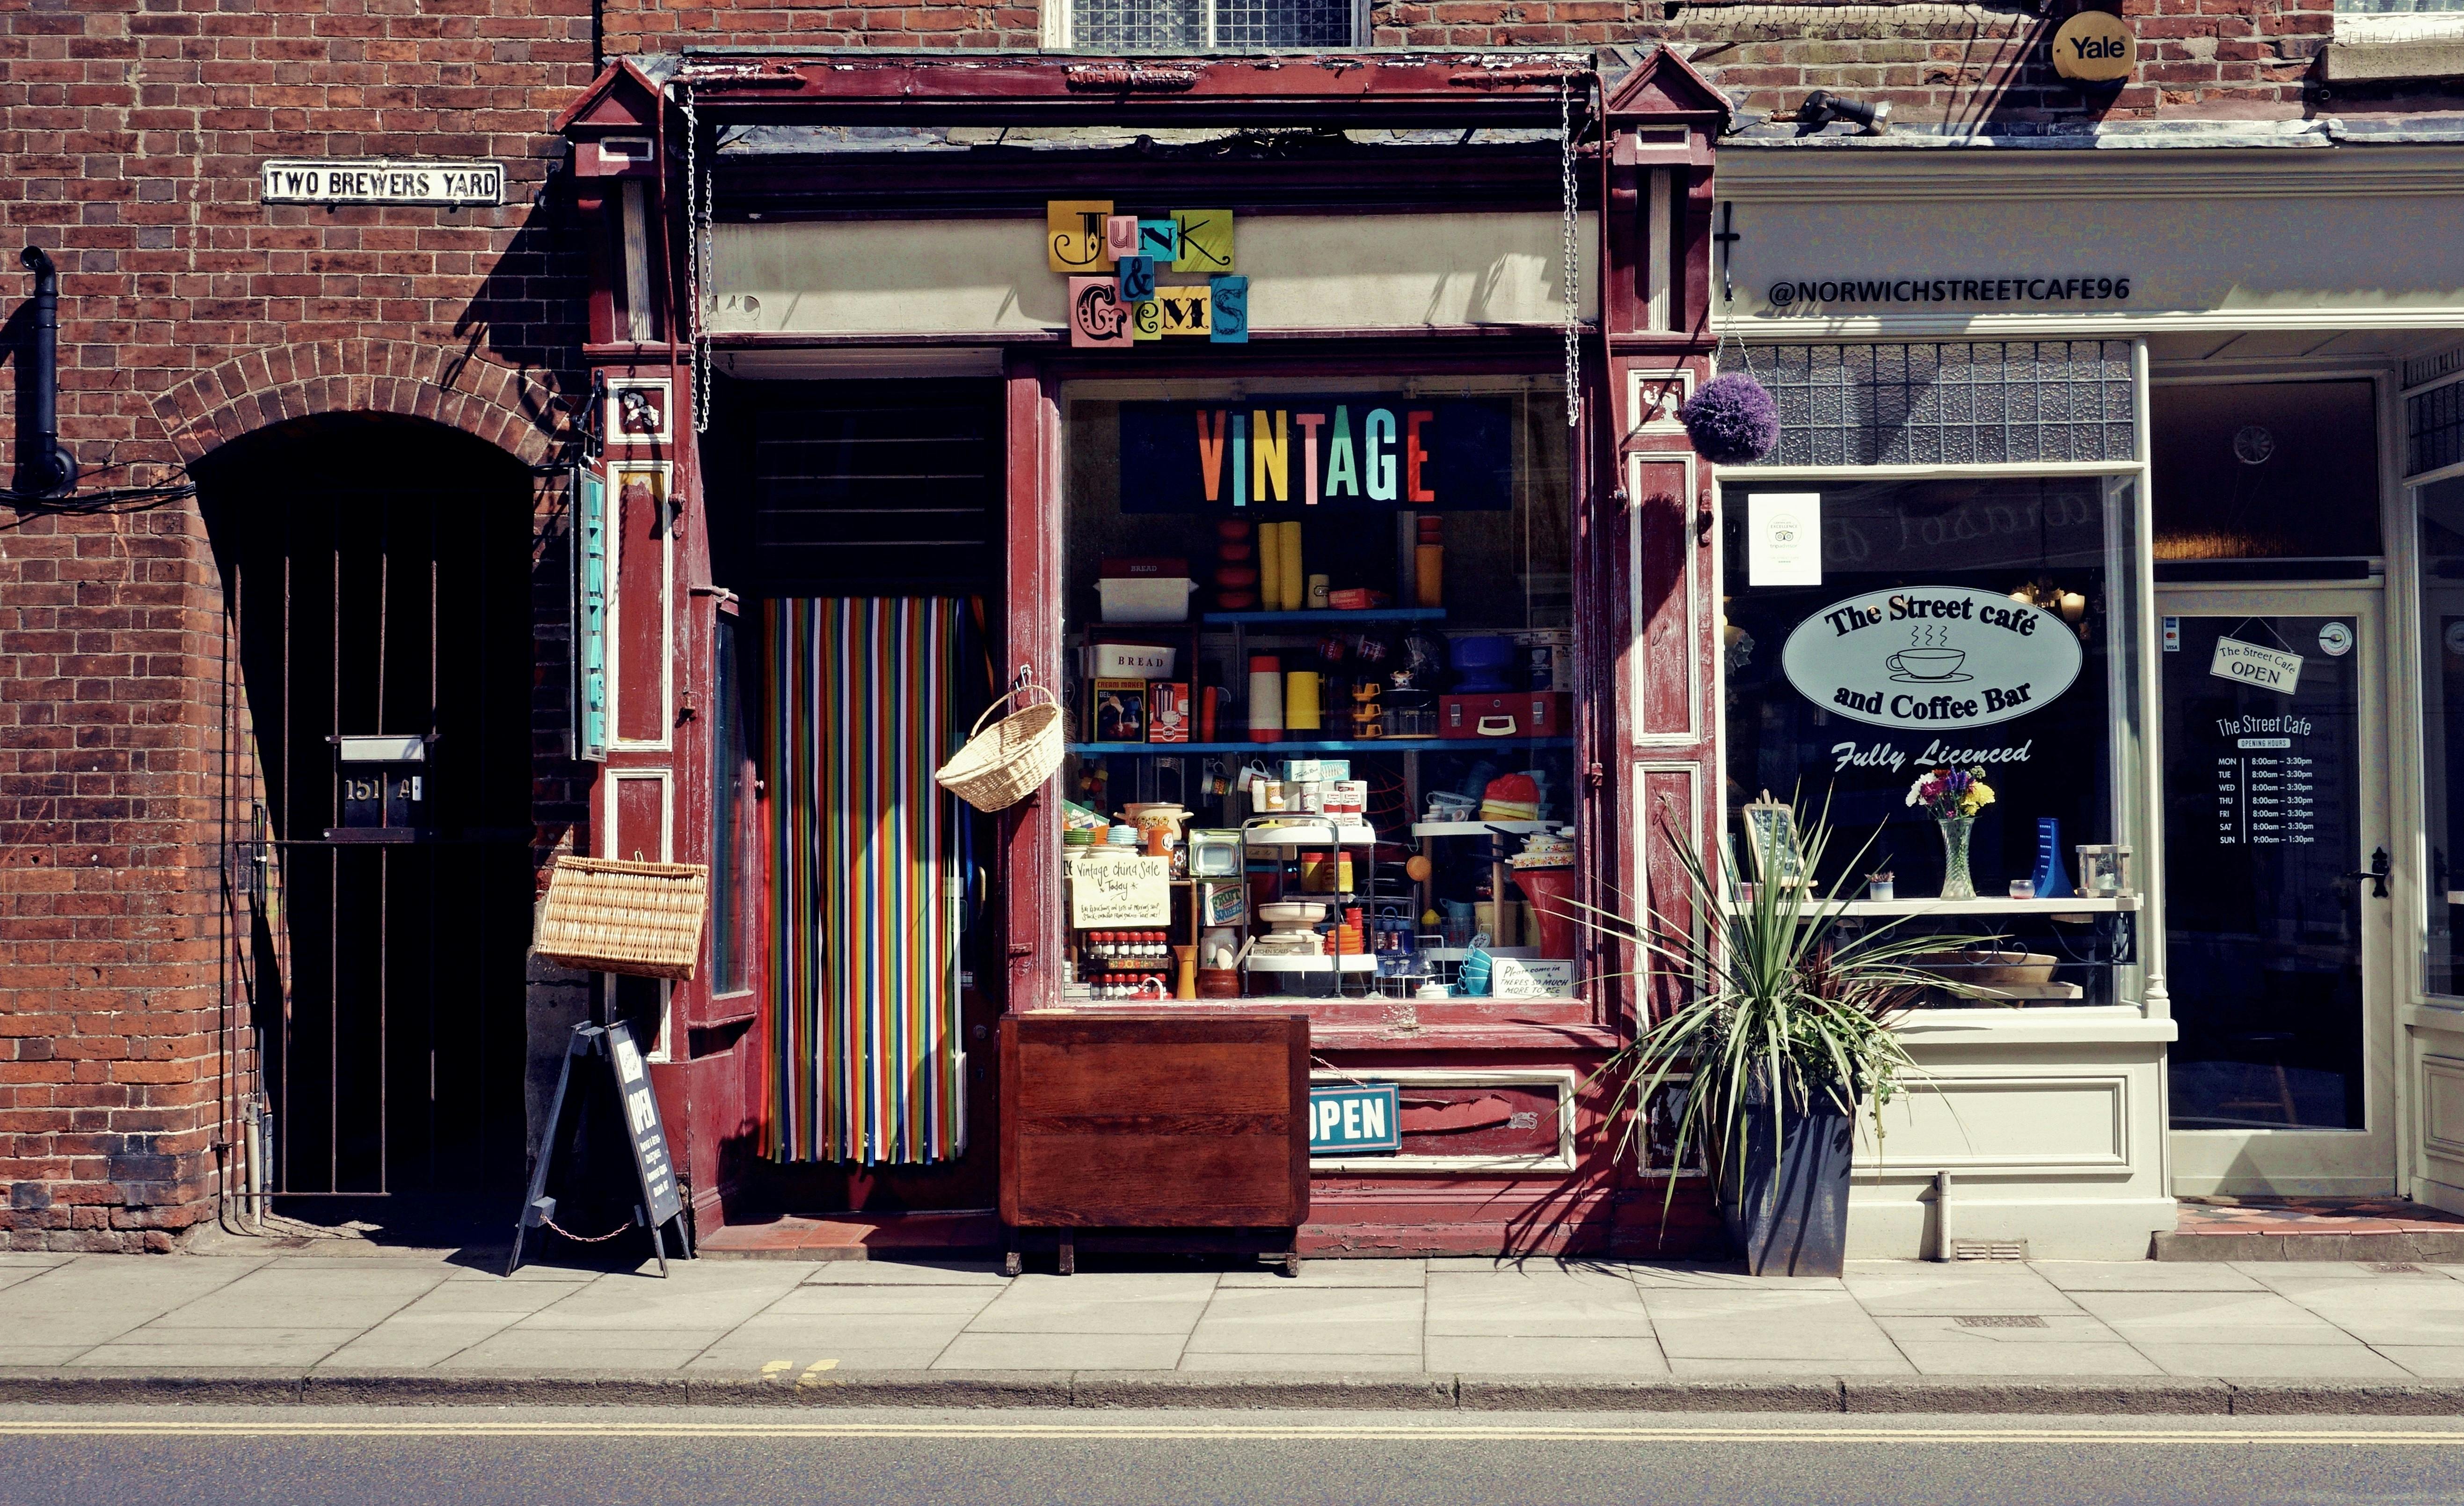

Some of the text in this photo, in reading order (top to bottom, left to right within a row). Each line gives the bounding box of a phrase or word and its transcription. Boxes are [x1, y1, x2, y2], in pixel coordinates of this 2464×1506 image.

[2070, 36, 2125, 59] Yale
[269, 171, 496, 197] TWO BREWERS YARD
[1124, 257, 1152, 300] &
[1769, 278, 2130, 307] @NORWICHSTREETCAFE96
[1196, 405, 1435, 506] VINTAGE
[589, 481, 605, 746] VINTAGE
[1824, 594, 2040, 636] The Street café
[1118, 656, 1164, 667] BREAD
[2219, 646, 2296, 674] The Street Café
[2231, 661, 2282, 685] OPEN
[1833, 681, 2032, 720] and Coffee Bar
[2216, 715, 2311, 737] The Street Cafe
[1831, 738, 2033, 773] Fully Licenced
[2286, 757, 2312, 766] 3:30pm
[2287, 770, 2312, 779] 3:30pm
[345, 778, 411, 800] 151 A
[2287, 784, 2312, 792] 3:30pm
[2287, 797, 2313, 805] 3:30pm
[2288, 810, 2313, 819] 3:30pm
[2288, 823, 2313, 831] 3:30pm
[2289, 835, 2314, 844] 1:30pm
[1077, 863, 1109, 887] Vintage
[1139, 861, 1160, 879] Sale
[1105, 879, 1128, 901] Today
[1210, 887, 1241, 909] FRUIT
[1503, 965, 1529, 978] Please
[628, 1087, 656, 1135] OPEN
